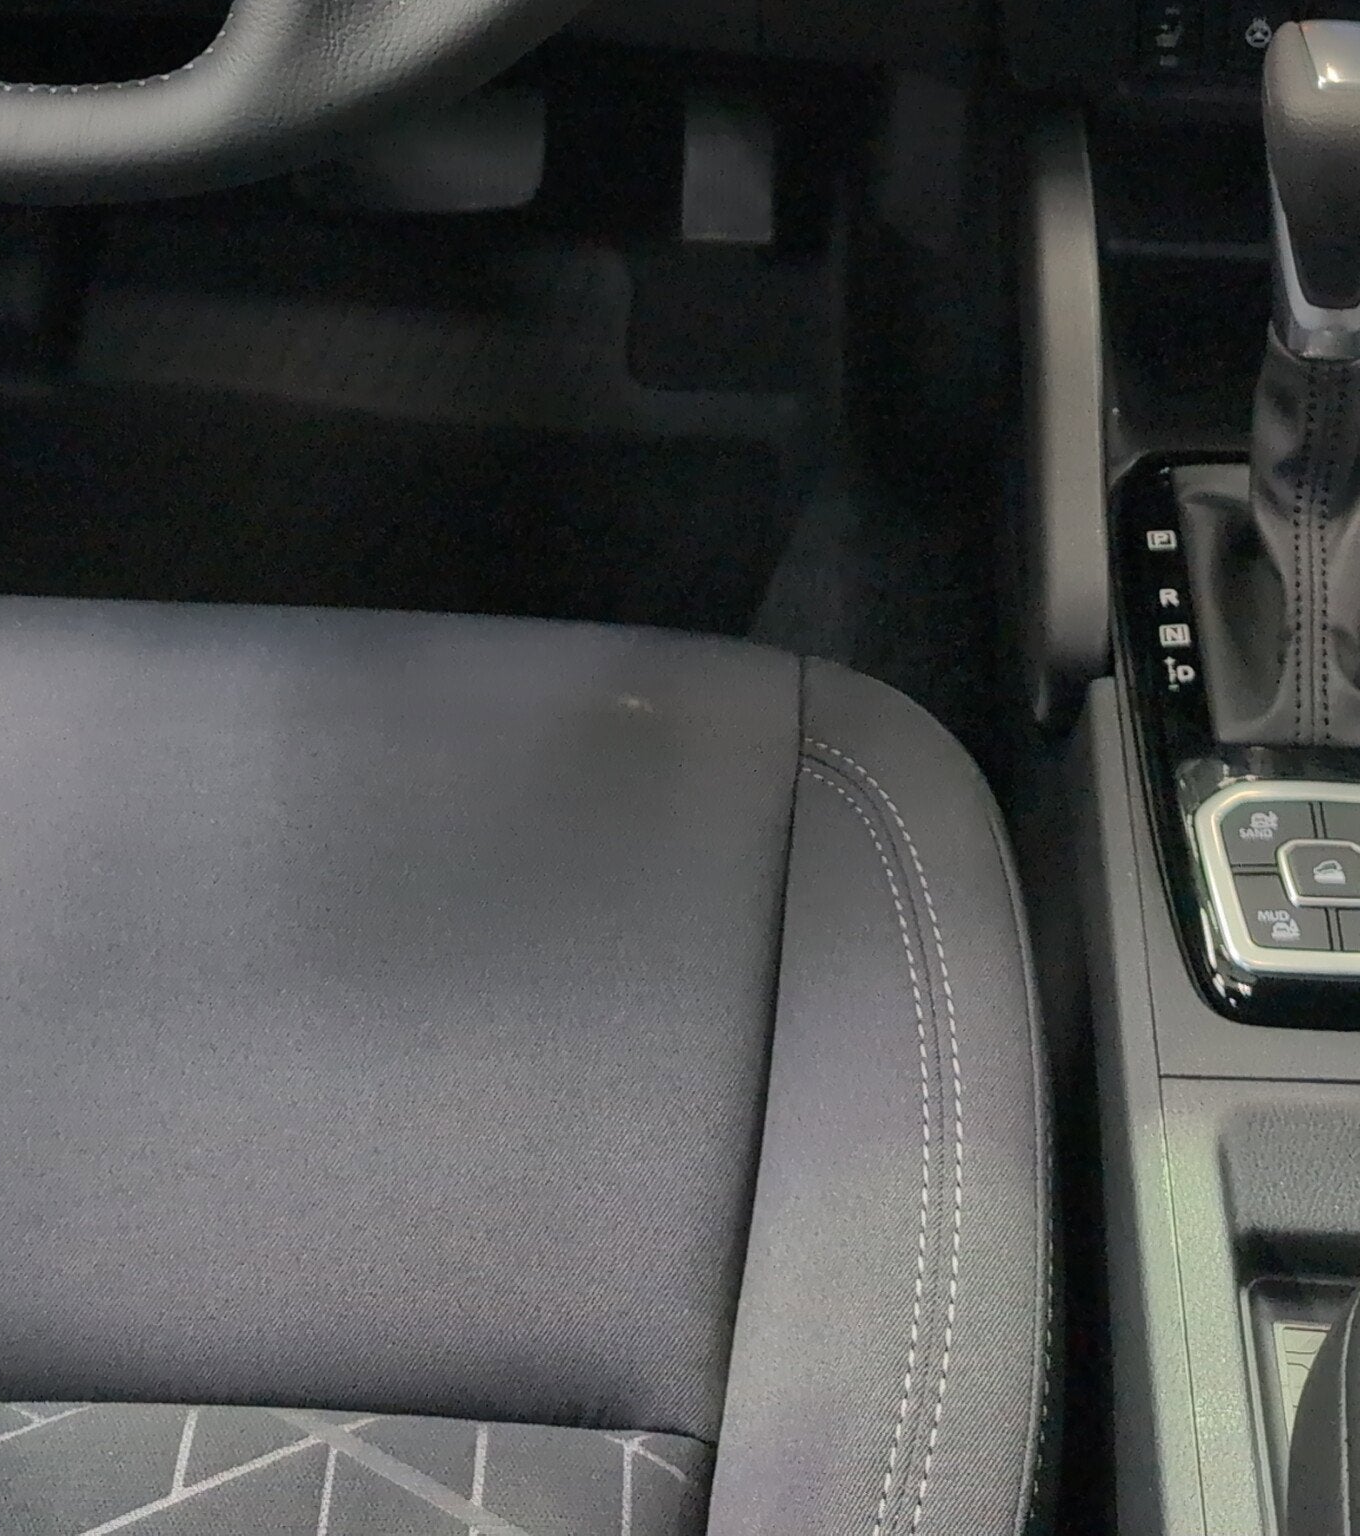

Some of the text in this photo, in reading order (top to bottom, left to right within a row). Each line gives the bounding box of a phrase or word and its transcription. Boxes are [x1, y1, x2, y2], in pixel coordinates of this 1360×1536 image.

[1159, 587, 1180, 608] R
[1177, 664, 1196, 683] D
[1239, 827, 1274, 840] SAND
[1257, 910, 1290, 922] MUD
